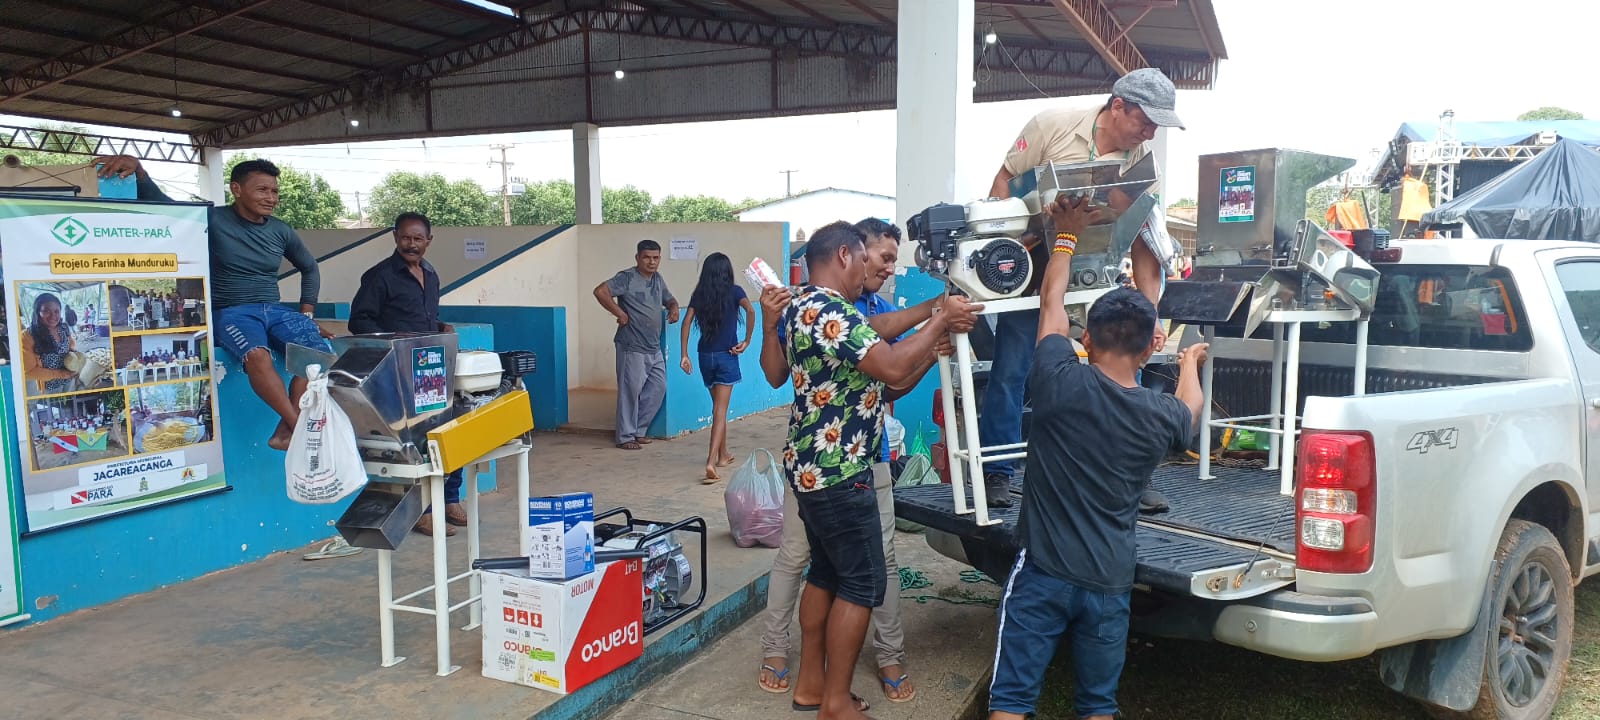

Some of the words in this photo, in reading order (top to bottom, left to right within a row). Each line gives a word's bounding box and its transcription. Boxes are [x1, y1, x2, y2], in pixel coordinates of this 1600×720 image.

[93, 226, 172, 238] EMATER-PARÁ
[54, 258, 90, 271] Projeto
[92, 257, 126, 268] Farinha
[128, 256, 175, 268] Munduruku
[93, 459, 173, 482] JACAREACANGA
[571, 578, 595, 597] MOTOR
[503, 640, 543, 655] anco
[581, 620, 639, 662] Branco
